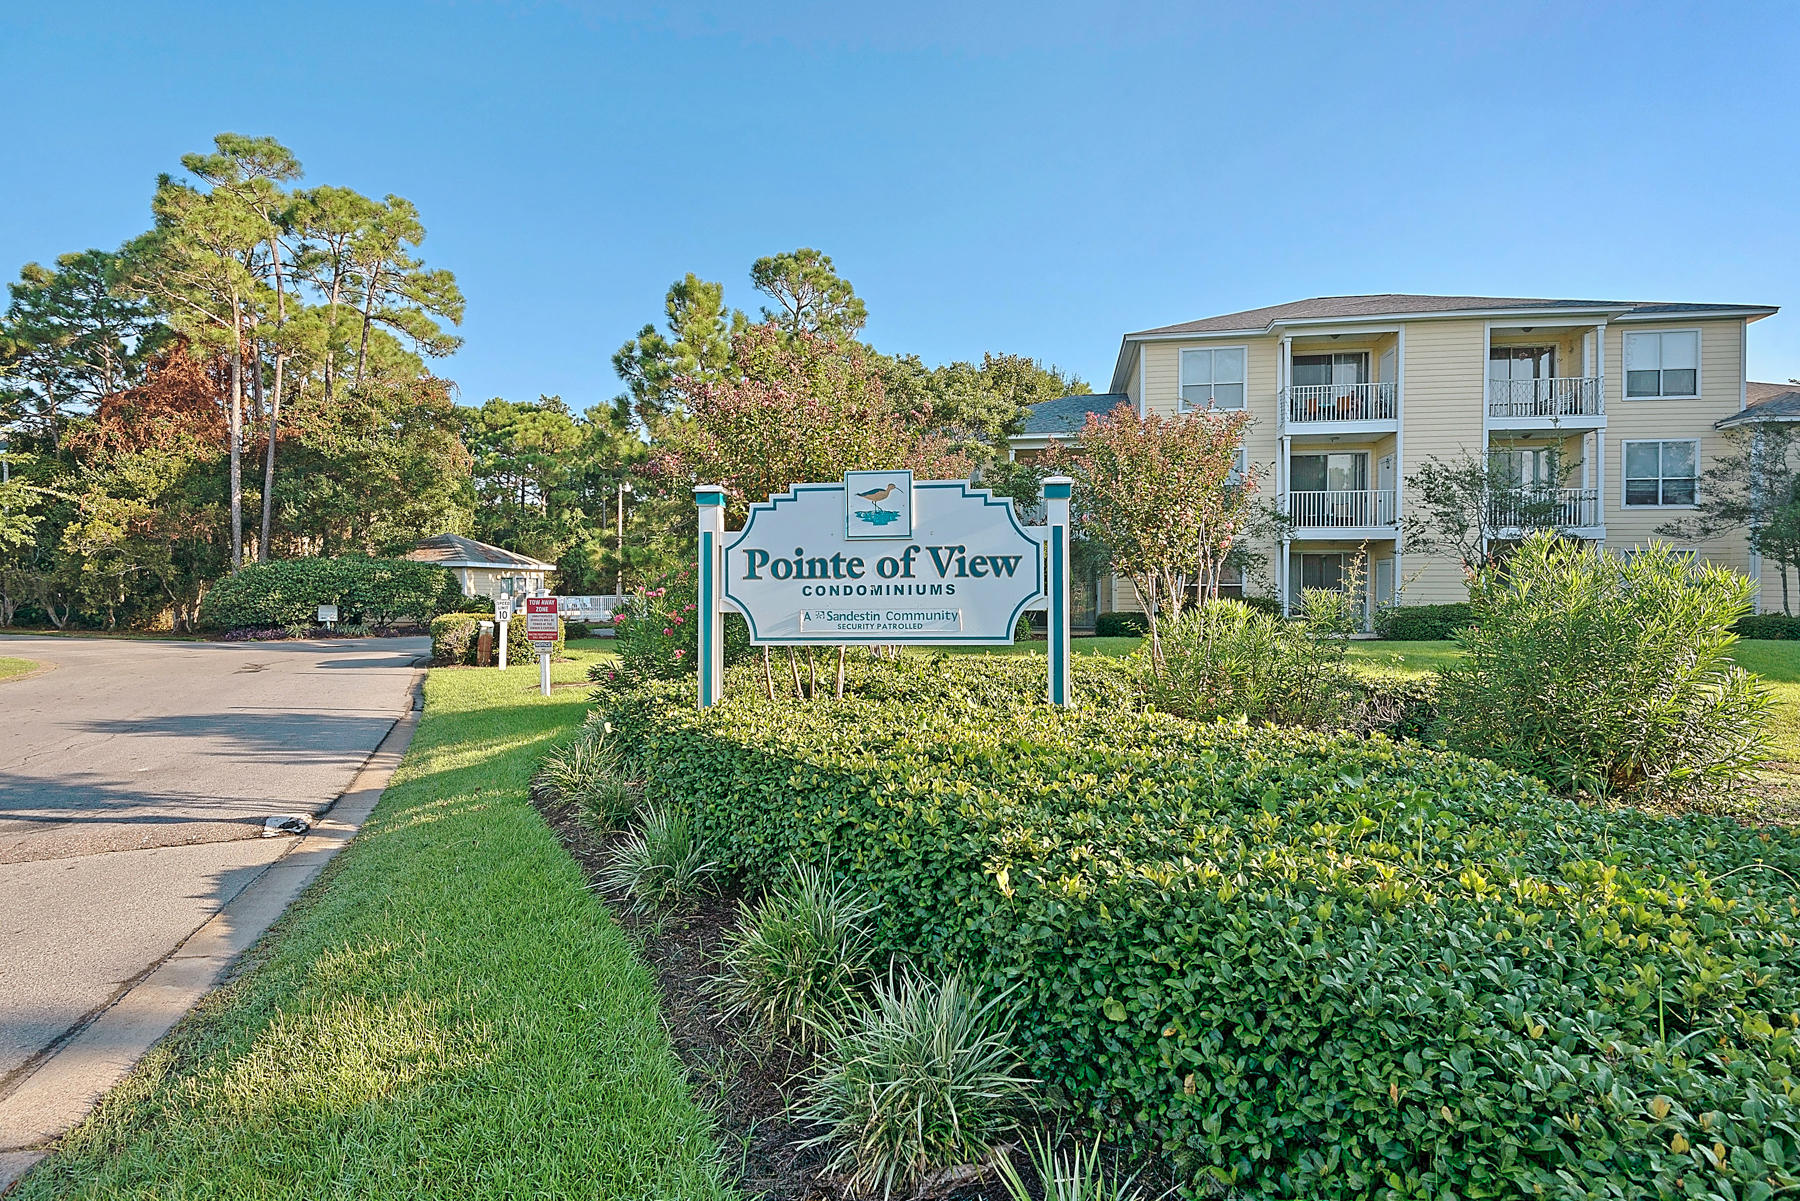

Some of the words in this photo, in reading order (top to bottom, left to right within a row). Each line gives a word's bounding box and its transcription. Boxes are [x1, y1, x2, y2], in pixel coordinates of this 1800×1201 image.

[742, 547, 865, 580] Pointe
[876, 545, 921, 579] of
[925, 545, 1023, 579] View
[802, 583, 956, 597] CONDOMINIUMS
[499, 610, 508, 619] 10
[803, 611, 812, 622] A
[826, 610, 881, 622] Sandestin
[885, 610, 958, 623] Community
